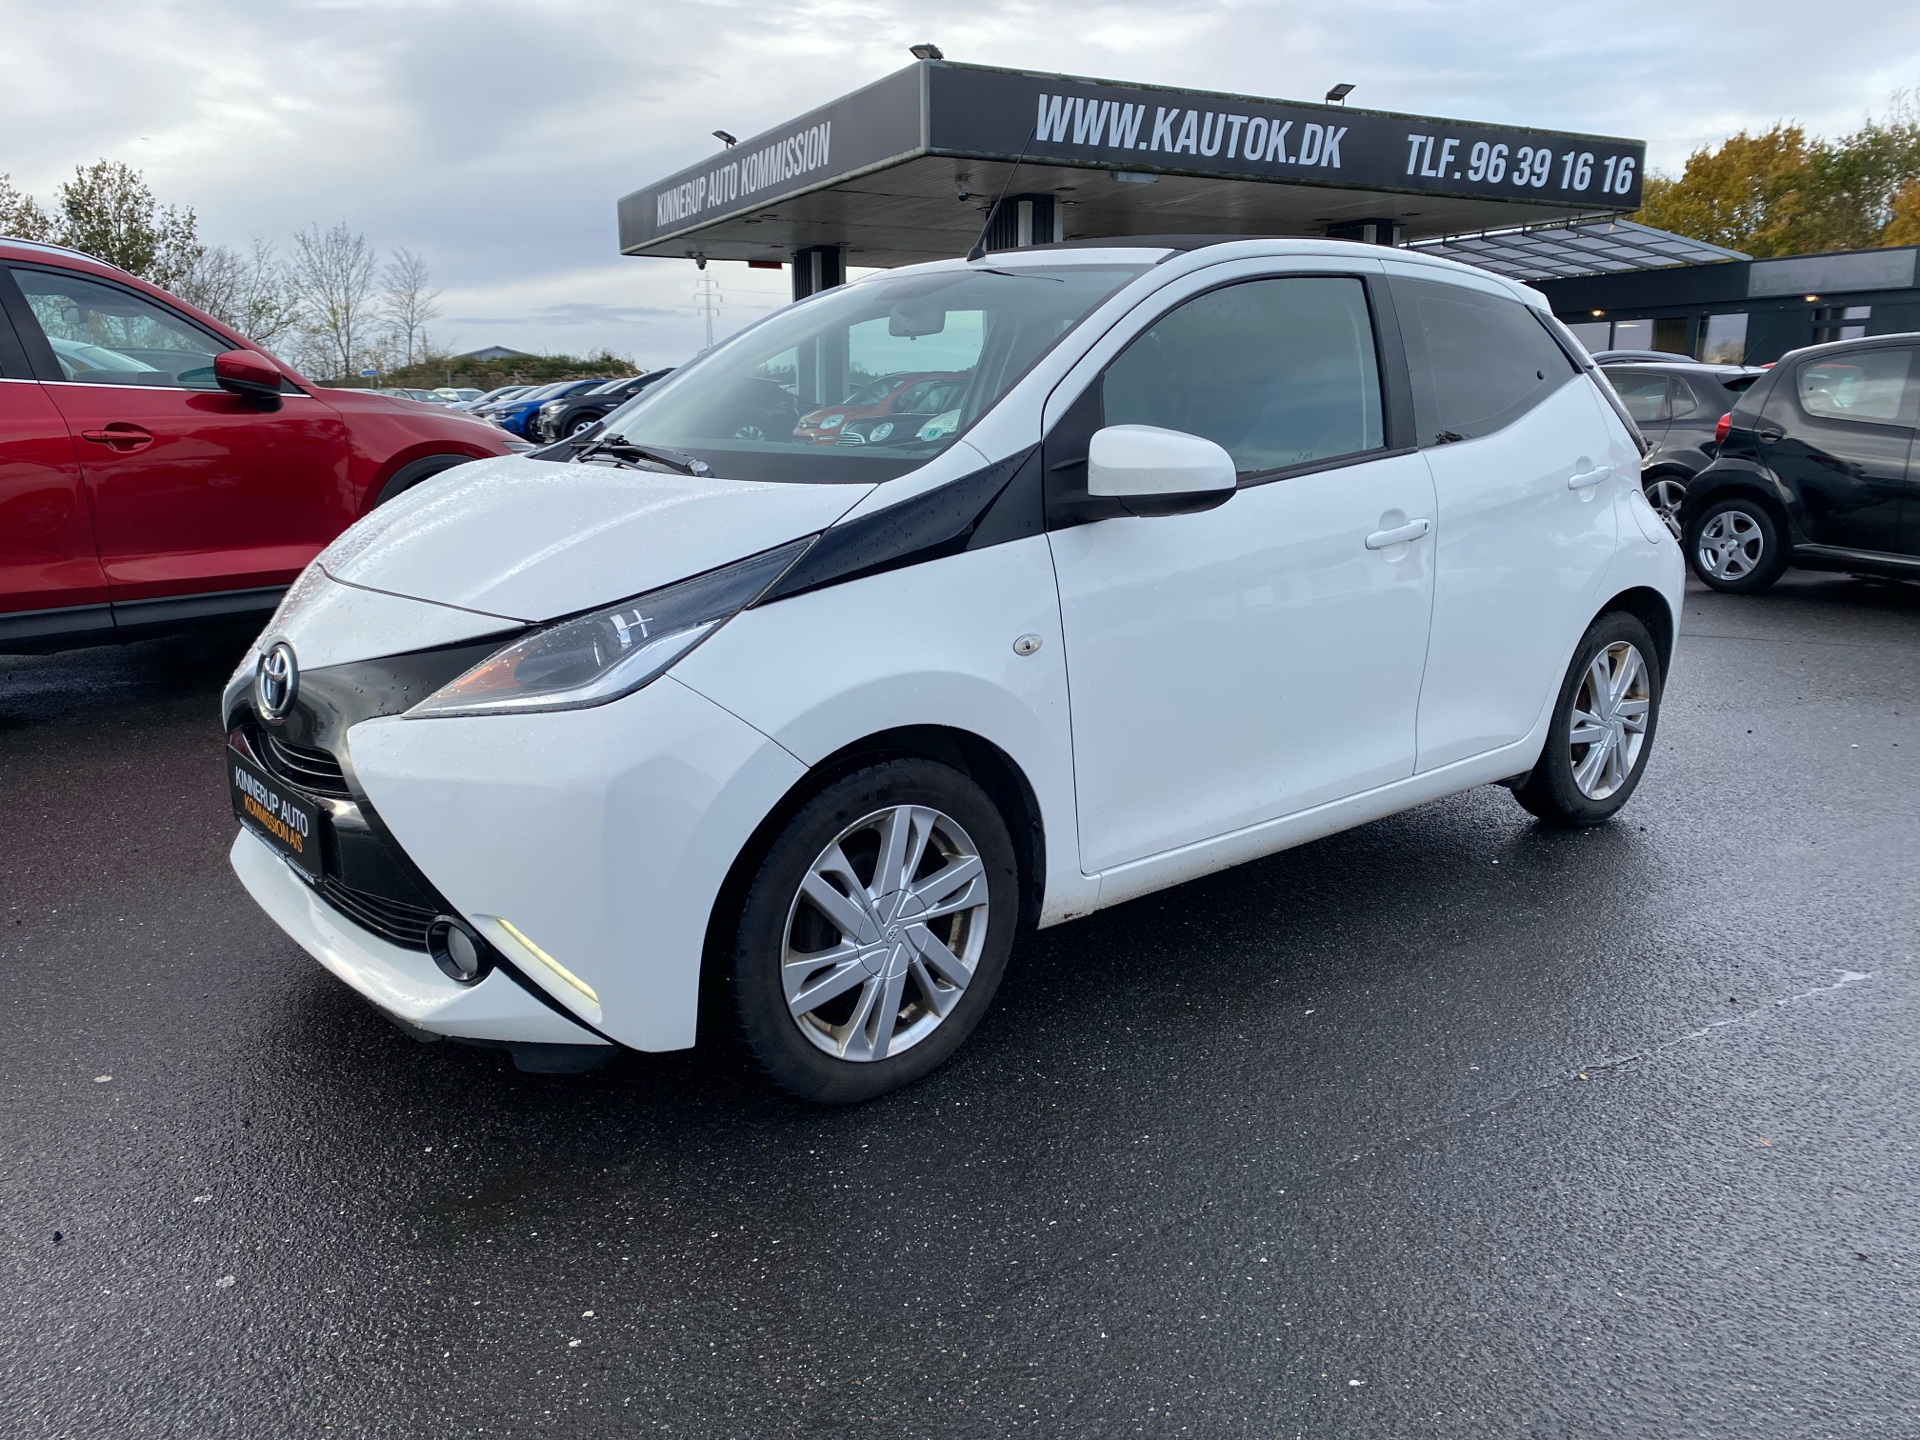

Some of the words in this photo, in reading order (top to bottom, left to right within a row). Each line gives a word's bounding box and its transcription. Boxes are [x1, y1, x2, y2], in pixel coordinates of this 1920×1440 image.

[1036, 93, 1348, 169] WWW.KAUTOK.DK
[1406, 133, 1462, 180] TLF.
[1467, 141, 1510, 184] 96
[1512, 146, 1553, 188] 39
[1560, 151, 1595, 192] 16
[1602, 156, 1636, 195] 16
[656, 176, 706, 227] KINNERUP
[707, 162, 738, 208] AUTO
[740, 121, 831, 196] KOMMISSION
[235, 766, 279, 814] KINNERUP
[281, 800, 309, 837] AUTO
[244, 794, 289, 842] KOMMISSION
[289, 829, 303, 853] A/S
